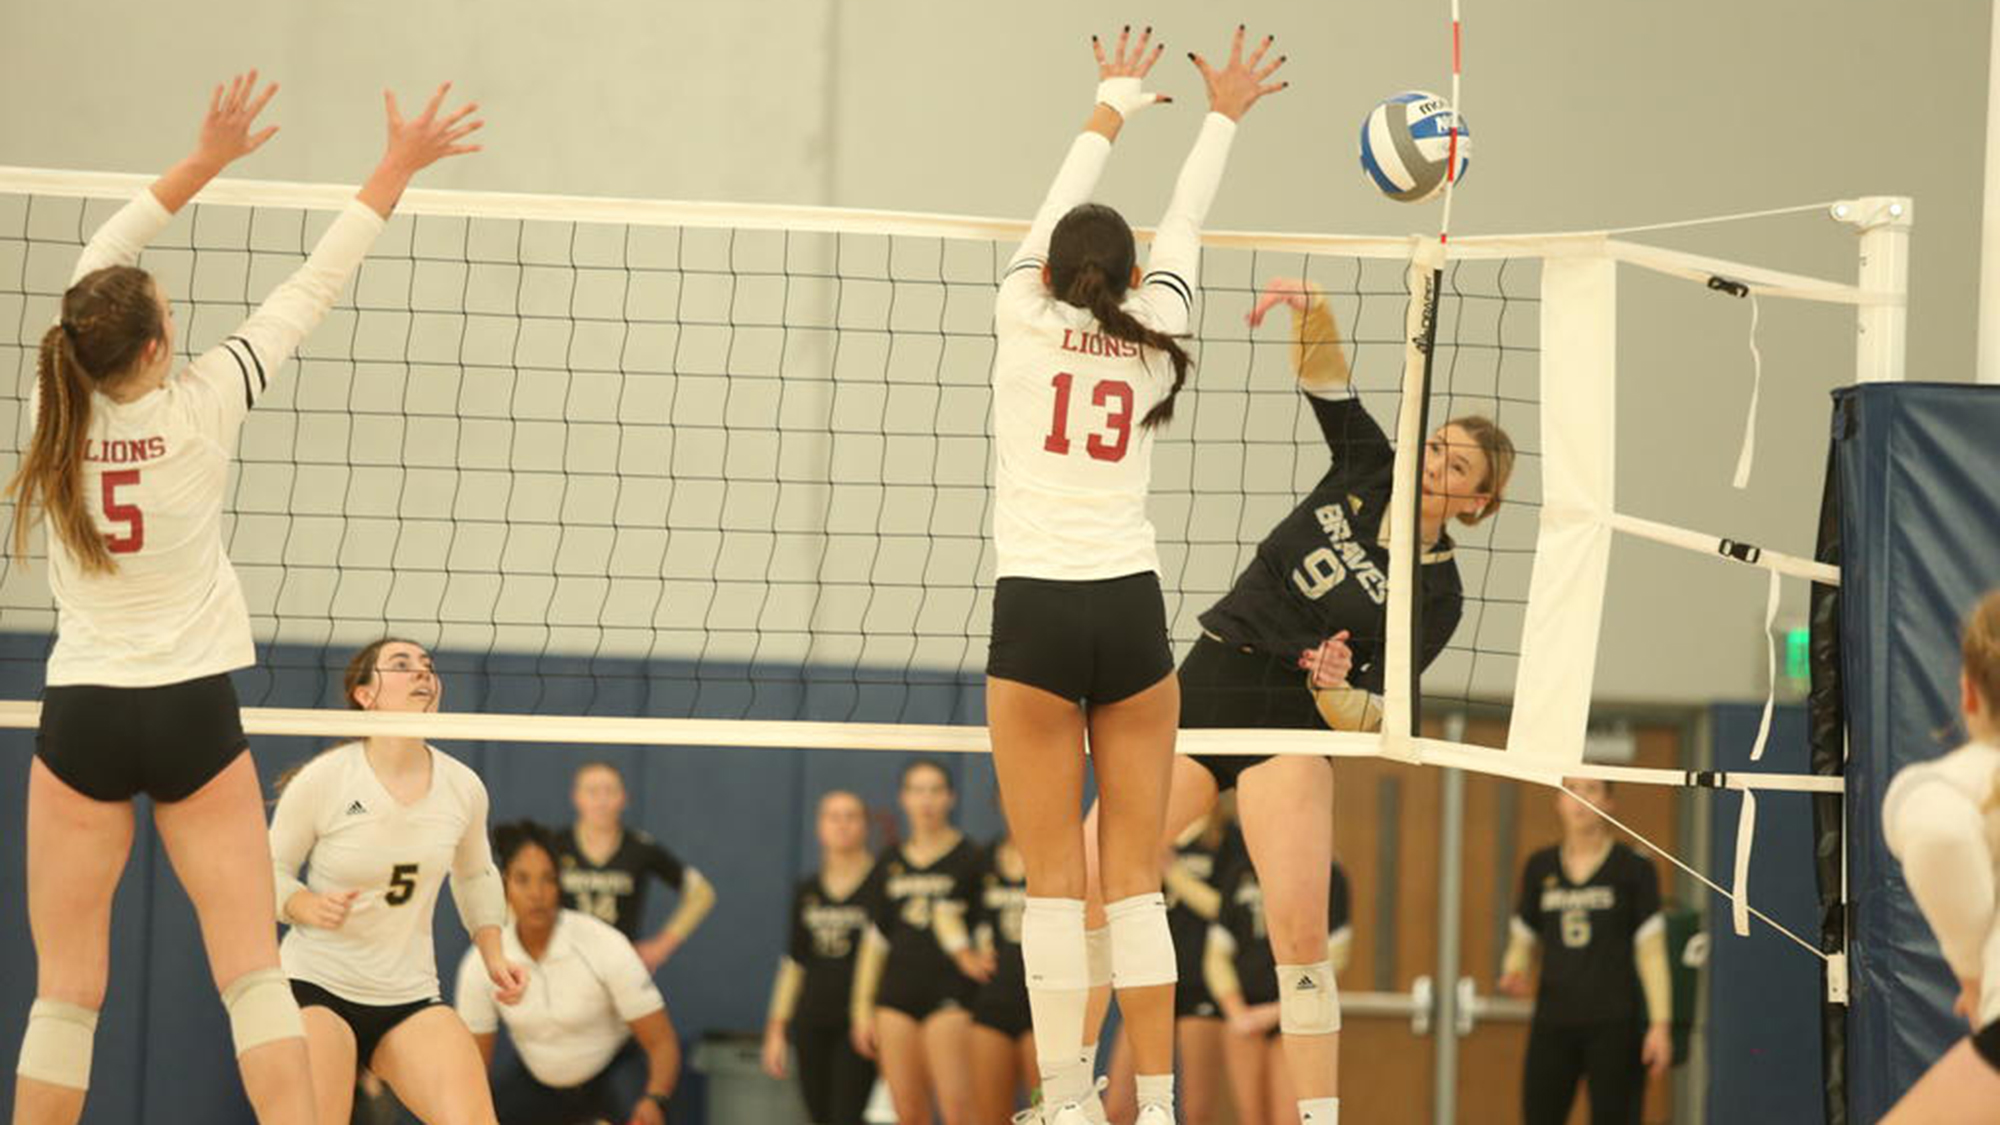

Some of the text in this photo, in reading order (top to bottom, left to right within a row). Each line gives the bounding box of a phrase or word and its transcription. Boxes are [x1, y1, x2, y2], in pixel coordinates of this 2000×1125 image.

[1061, 328, 1138, 358] LIONS
[1044, 371, 1134, 463] 13
[83, 436, 166, 463] LIONS
[100, 469, 144, 554] 5
[1292, 547, 1347, 600] 9
[1314, 503, 1389, 604] BRAVES
[385, 863, 419, 907] 5
[1561, 910, 1592, 949] 6
